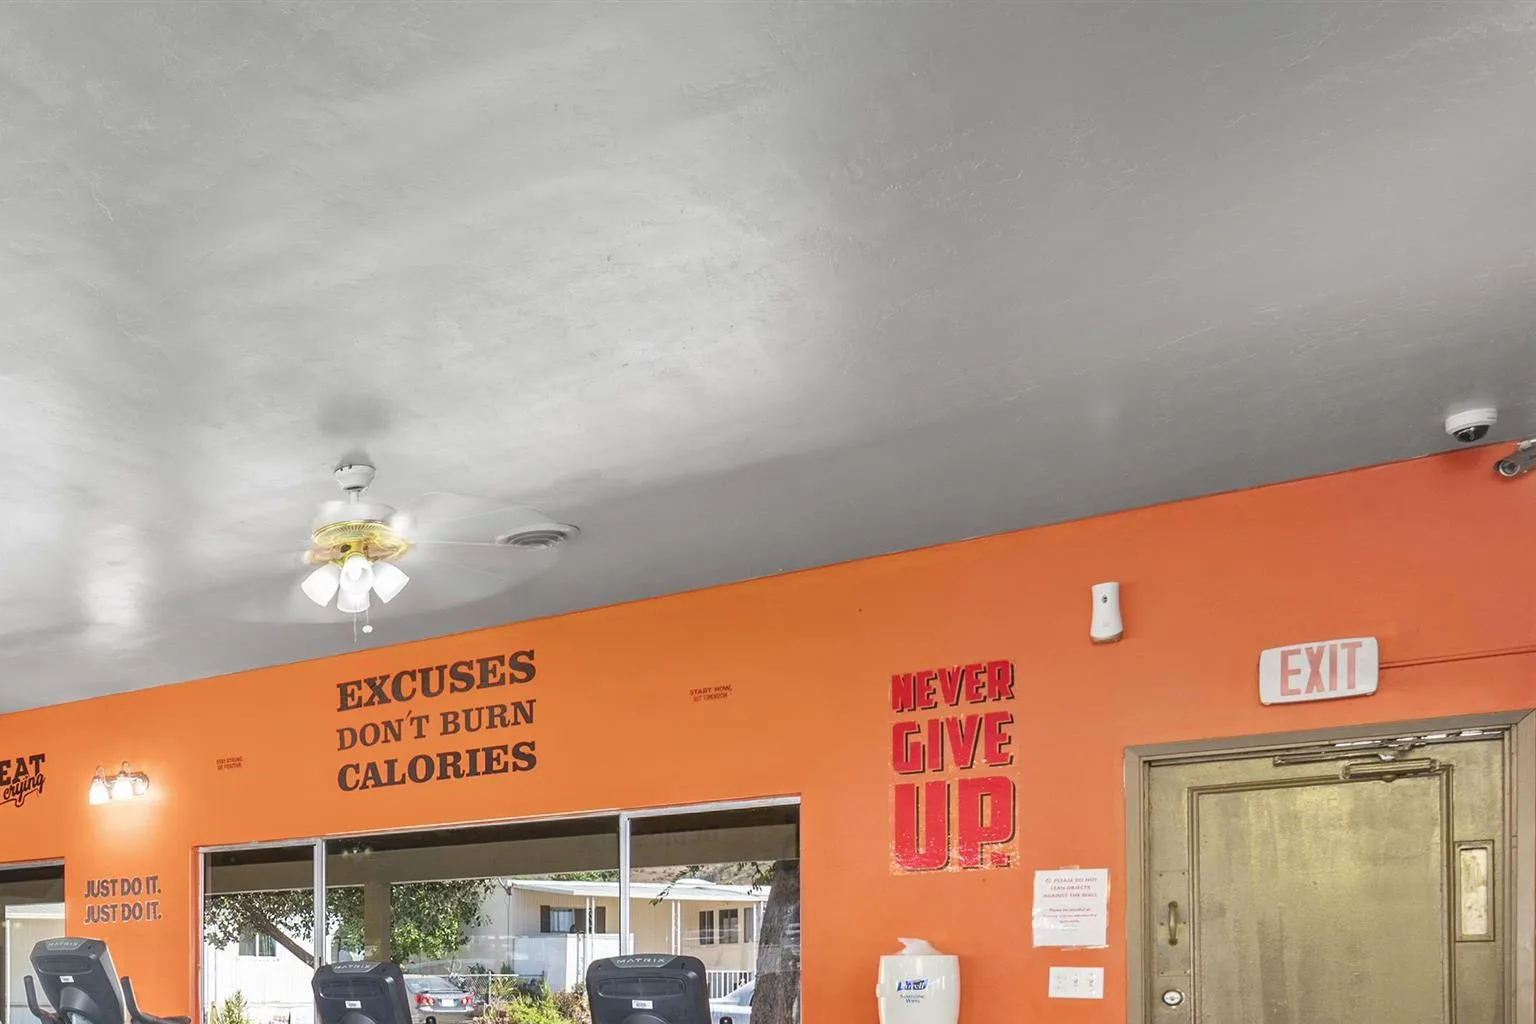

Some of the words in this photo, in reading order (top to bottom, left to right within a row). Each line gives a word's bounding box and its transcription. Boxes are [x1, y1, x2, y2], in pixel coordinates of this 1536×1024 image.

[336, 649, 536, 713] EXCUSES
[891, 660, 1015, 713] NEVER
[1280, 641, 1362, 697] EXIT
[336, 709, 430, 752] DON'T
[439, 699, 537, 736] BURN
[892, 711, 1015, 775] GIVE
[3, 772, 46, 804] crying
[337, 740, 537, 792] CALORIES
[894, 776, 1016, 872] UP.
[84, 879, 118, 898] JUST
[120, 877, 143, 897] DO
[145, 875, 162, 896] IT.
[84, 904, 118, 924] JUST
[121, 902, 143, 921] DO
[146, 901, 162, 920] IT.
